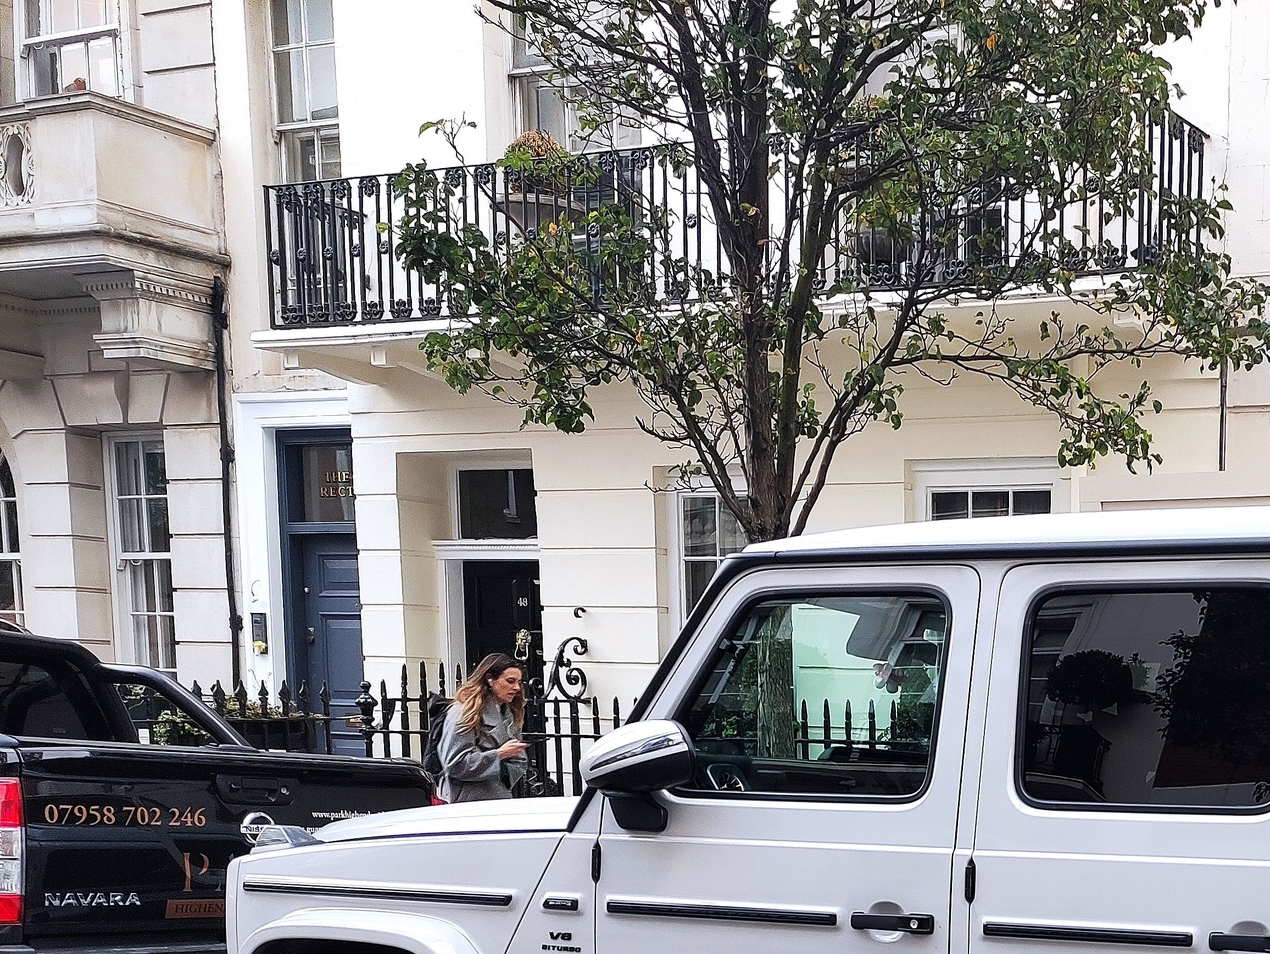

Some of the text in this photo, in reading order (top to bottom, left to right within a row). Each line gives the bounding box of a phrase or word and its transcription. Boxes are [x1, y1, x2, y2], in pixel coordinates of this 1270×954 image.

[320, 486, 354, 497] RECT
[44, 804, 206, 827] 07958 702 246
[44, 892, 141, 907] NAVARA
[175, 903, 226, 914] HIGHEN
[549, 931, 572, 941] V8
[541, 944, 581, 953] BITURBO
